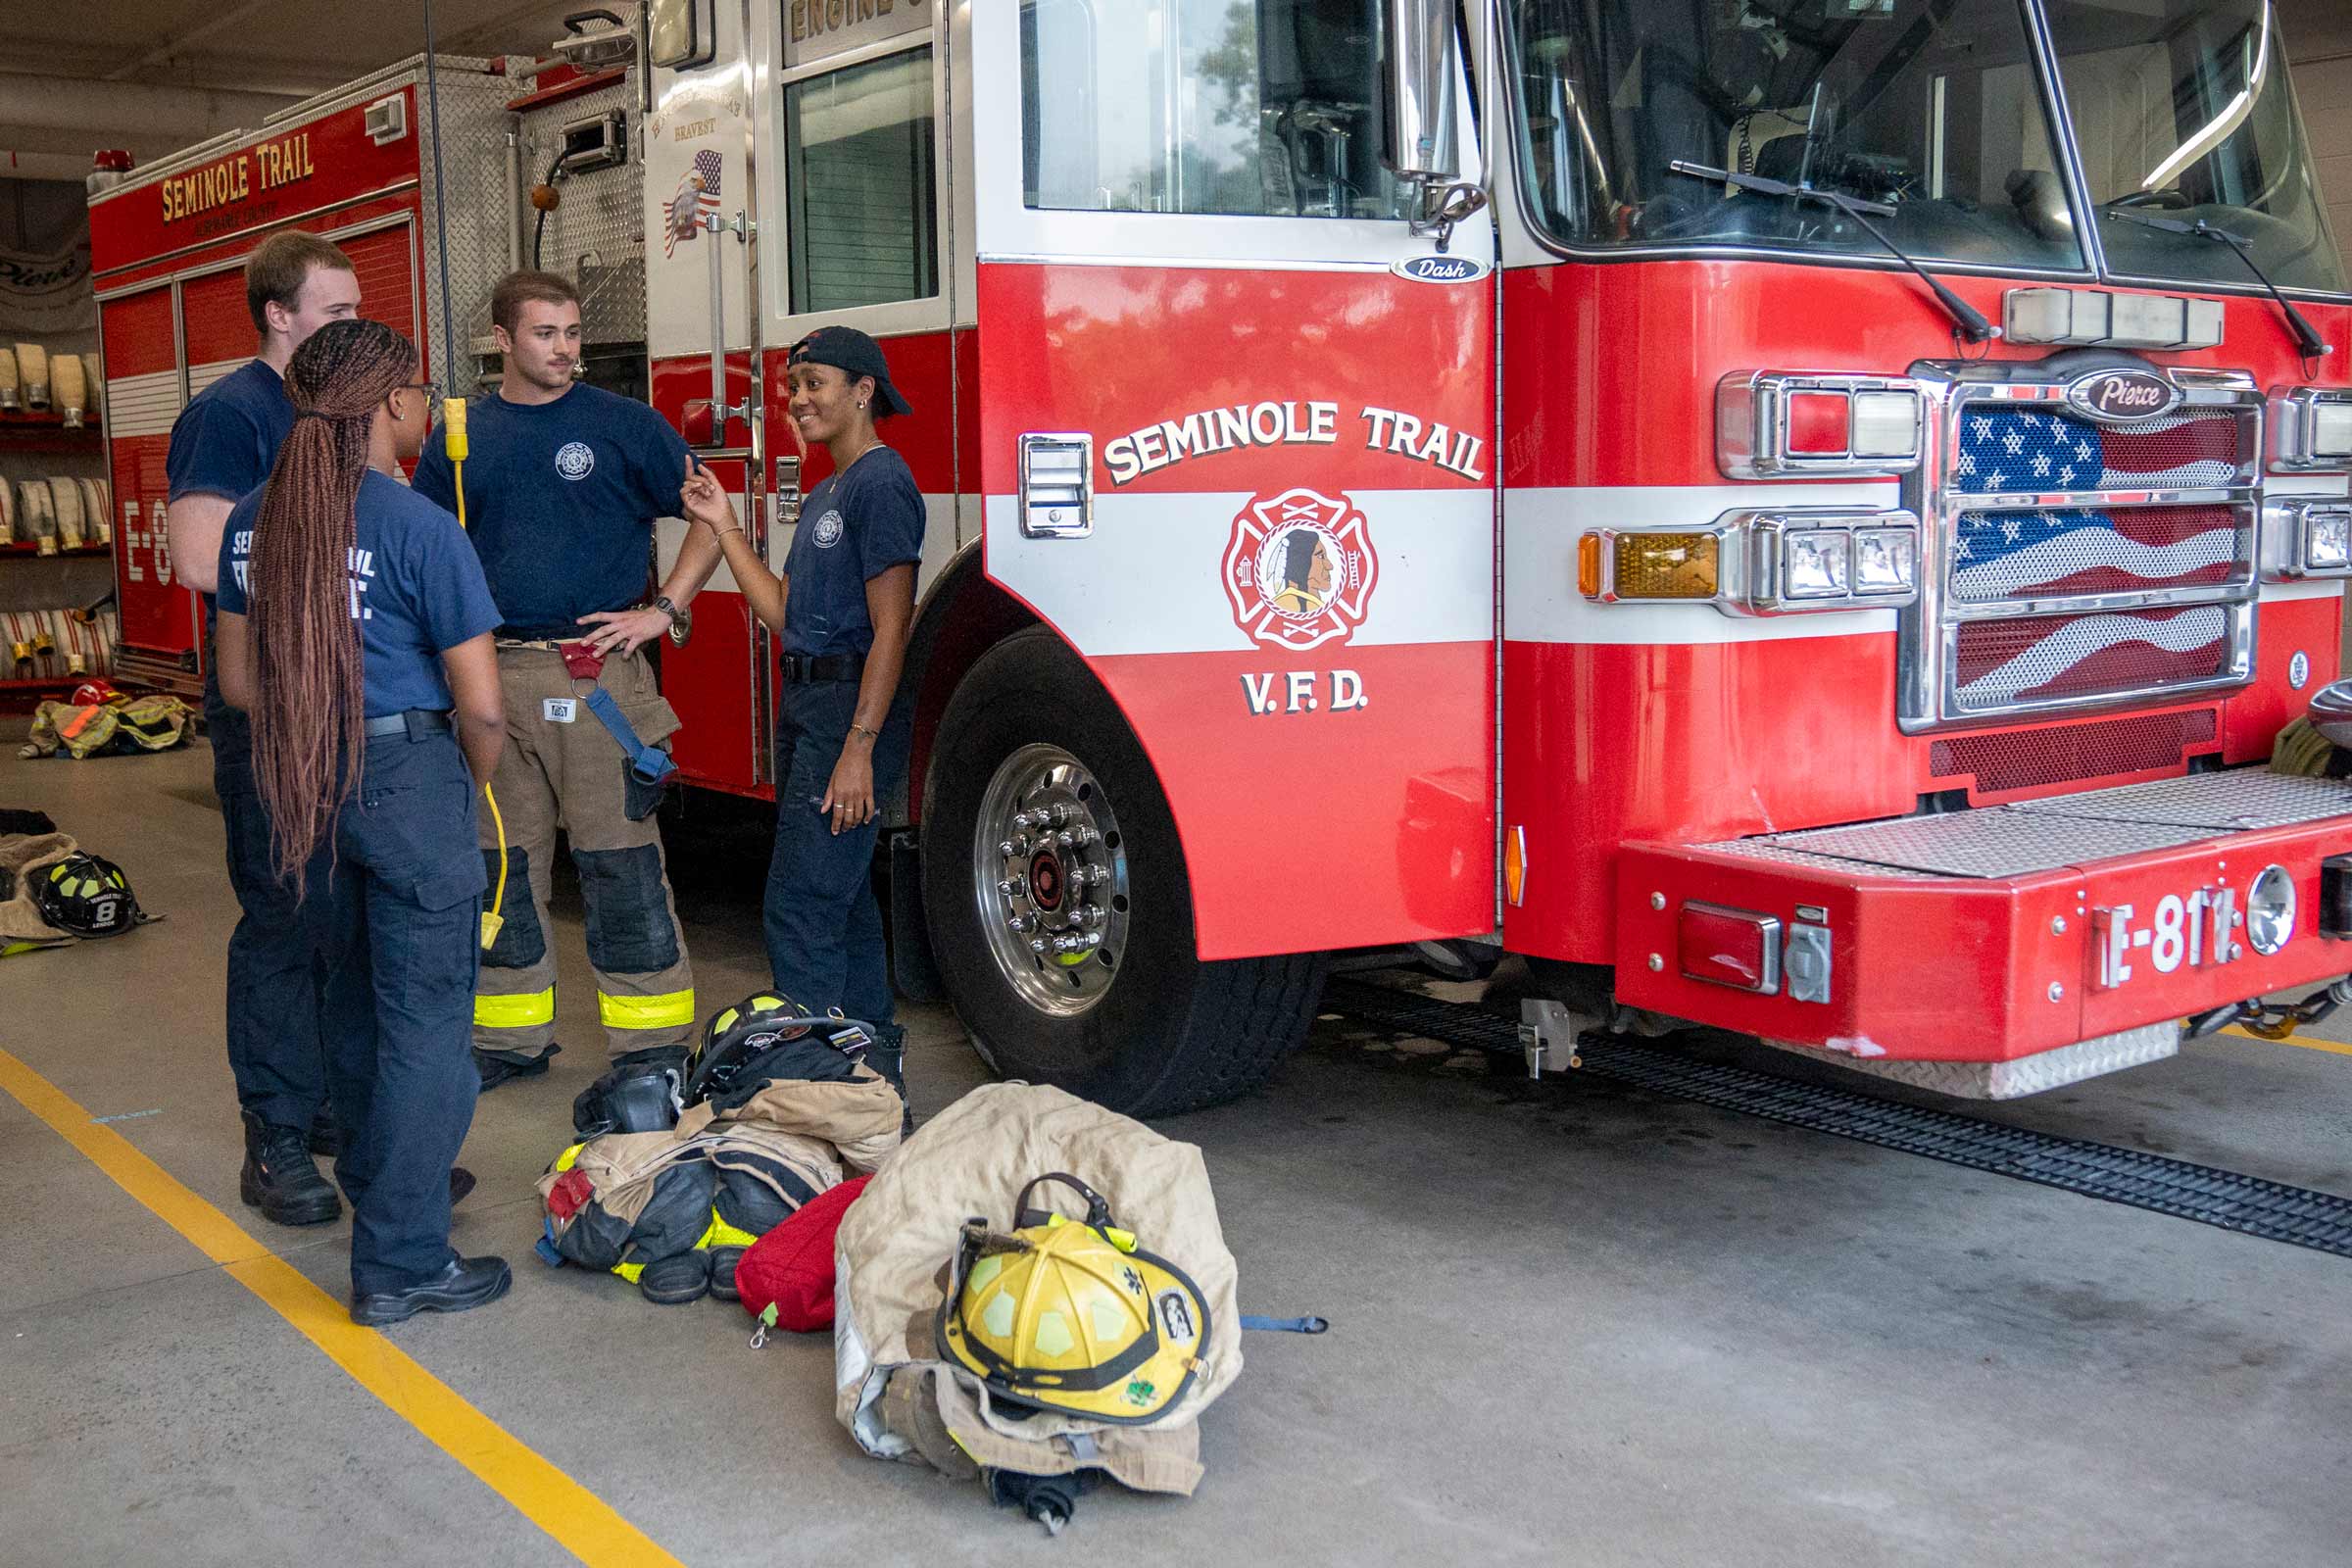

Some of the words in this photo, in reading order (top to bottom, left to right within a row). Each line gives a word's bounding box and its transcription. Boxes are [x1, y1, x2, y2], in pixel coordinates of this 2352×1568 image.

[163, 156, 249, 222] SEMINOLE
[256, 132, 314, 190] TRAIL
[1417, 259, 1467, 278] Dash
[2099, 376, 2160, 411] Pierce
[1103, 402, 1339, 487] SEMINOLE
[1360, 406, 1485, 481] TRAIL
[96, 901, 117, 922] 8
